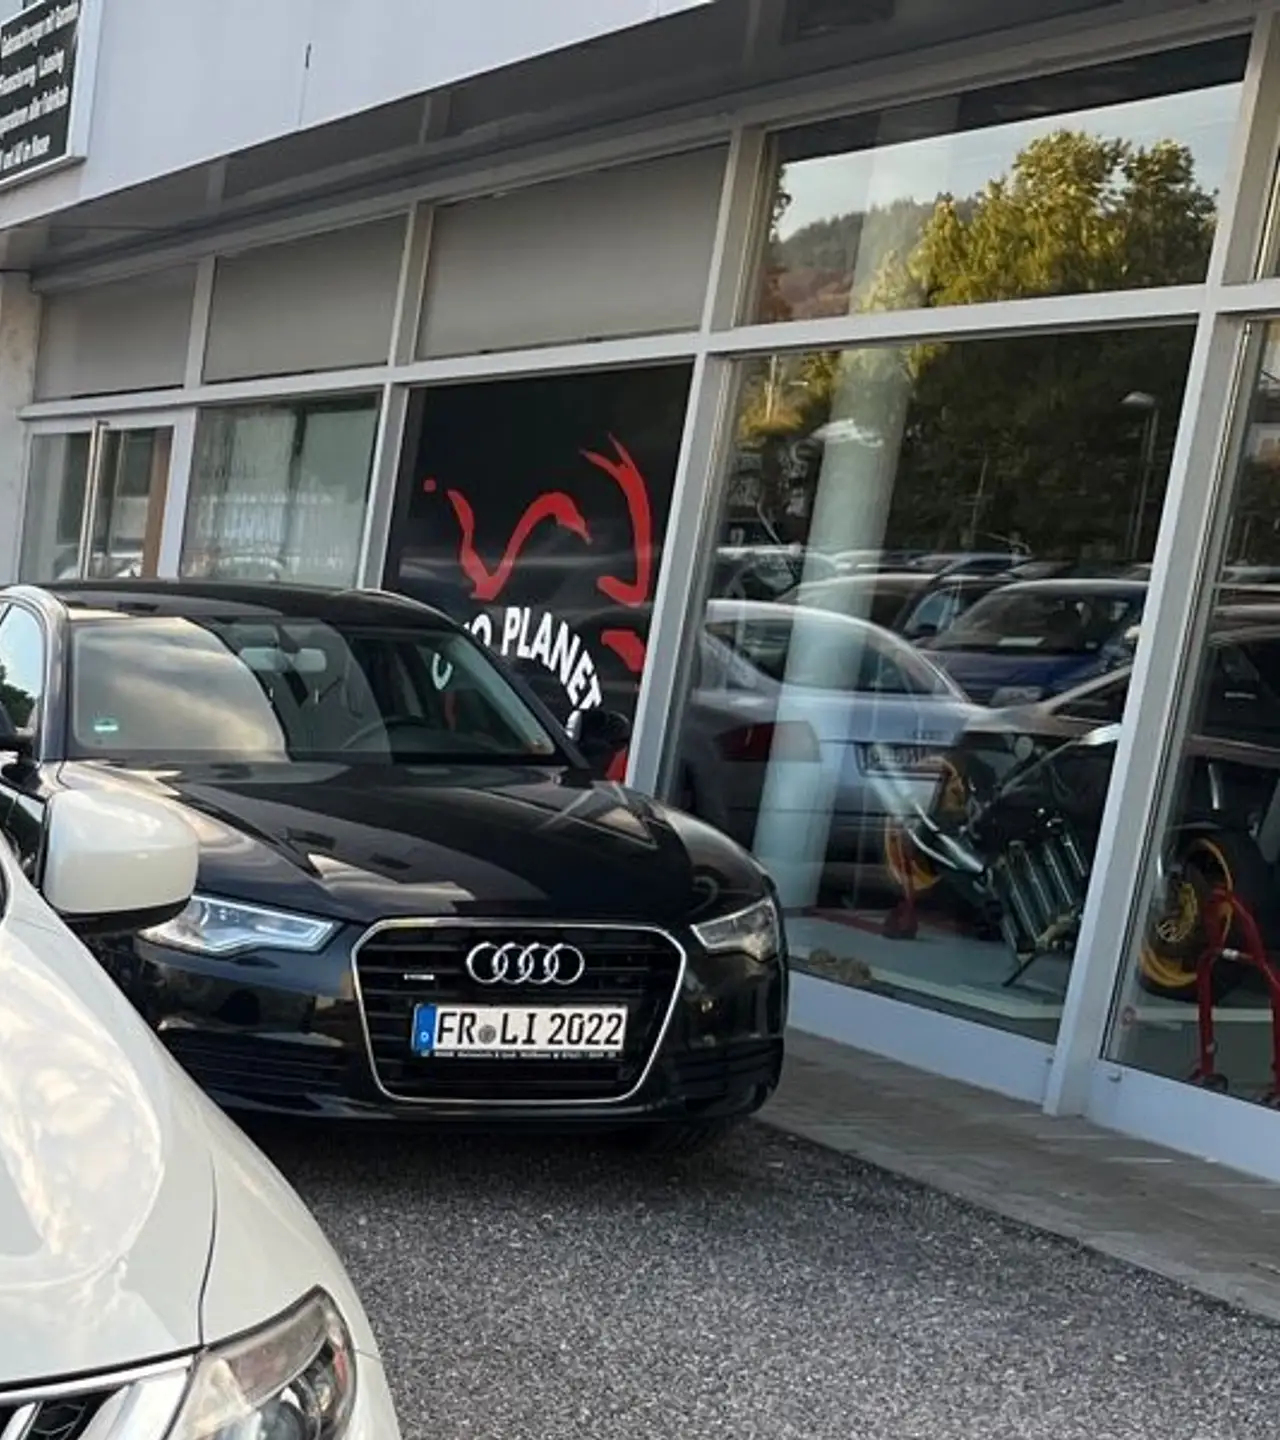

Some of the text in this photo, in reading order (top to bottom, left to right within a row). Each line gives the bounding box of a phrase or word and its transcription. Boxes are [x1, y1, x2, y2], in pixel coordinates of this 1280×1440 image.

[501, 606, 603, 710] PLANET
[437, 1012, 477, 1045] FR
[500, 1012, 539, 1045] LI
[548, 1012, 623, 1046] 2022
